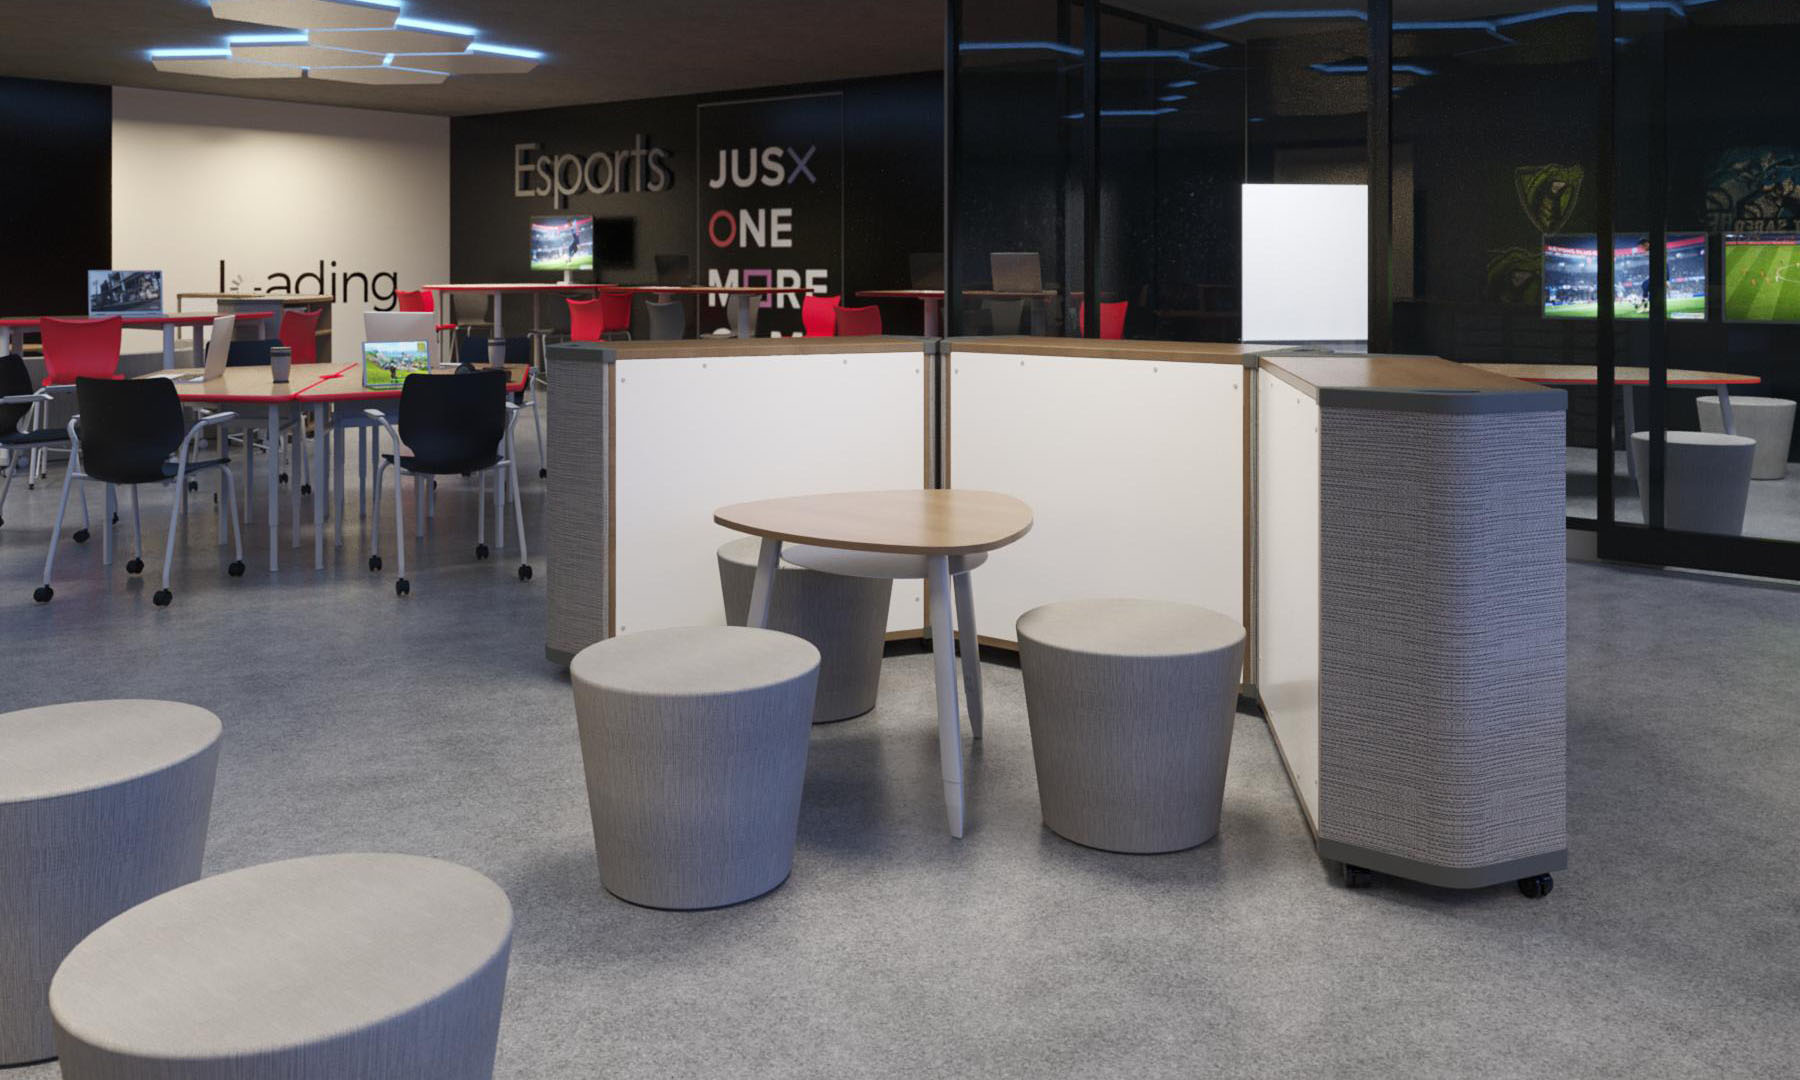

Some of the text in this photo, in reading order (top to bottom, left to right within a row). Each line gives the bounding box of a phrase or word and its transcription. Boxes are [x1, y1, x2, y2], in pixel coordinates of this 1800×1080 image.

[515, 133, 665, 210] Esports
[709, 208, 793, 248] ONE
[220, 259, 397, 312] Lading
